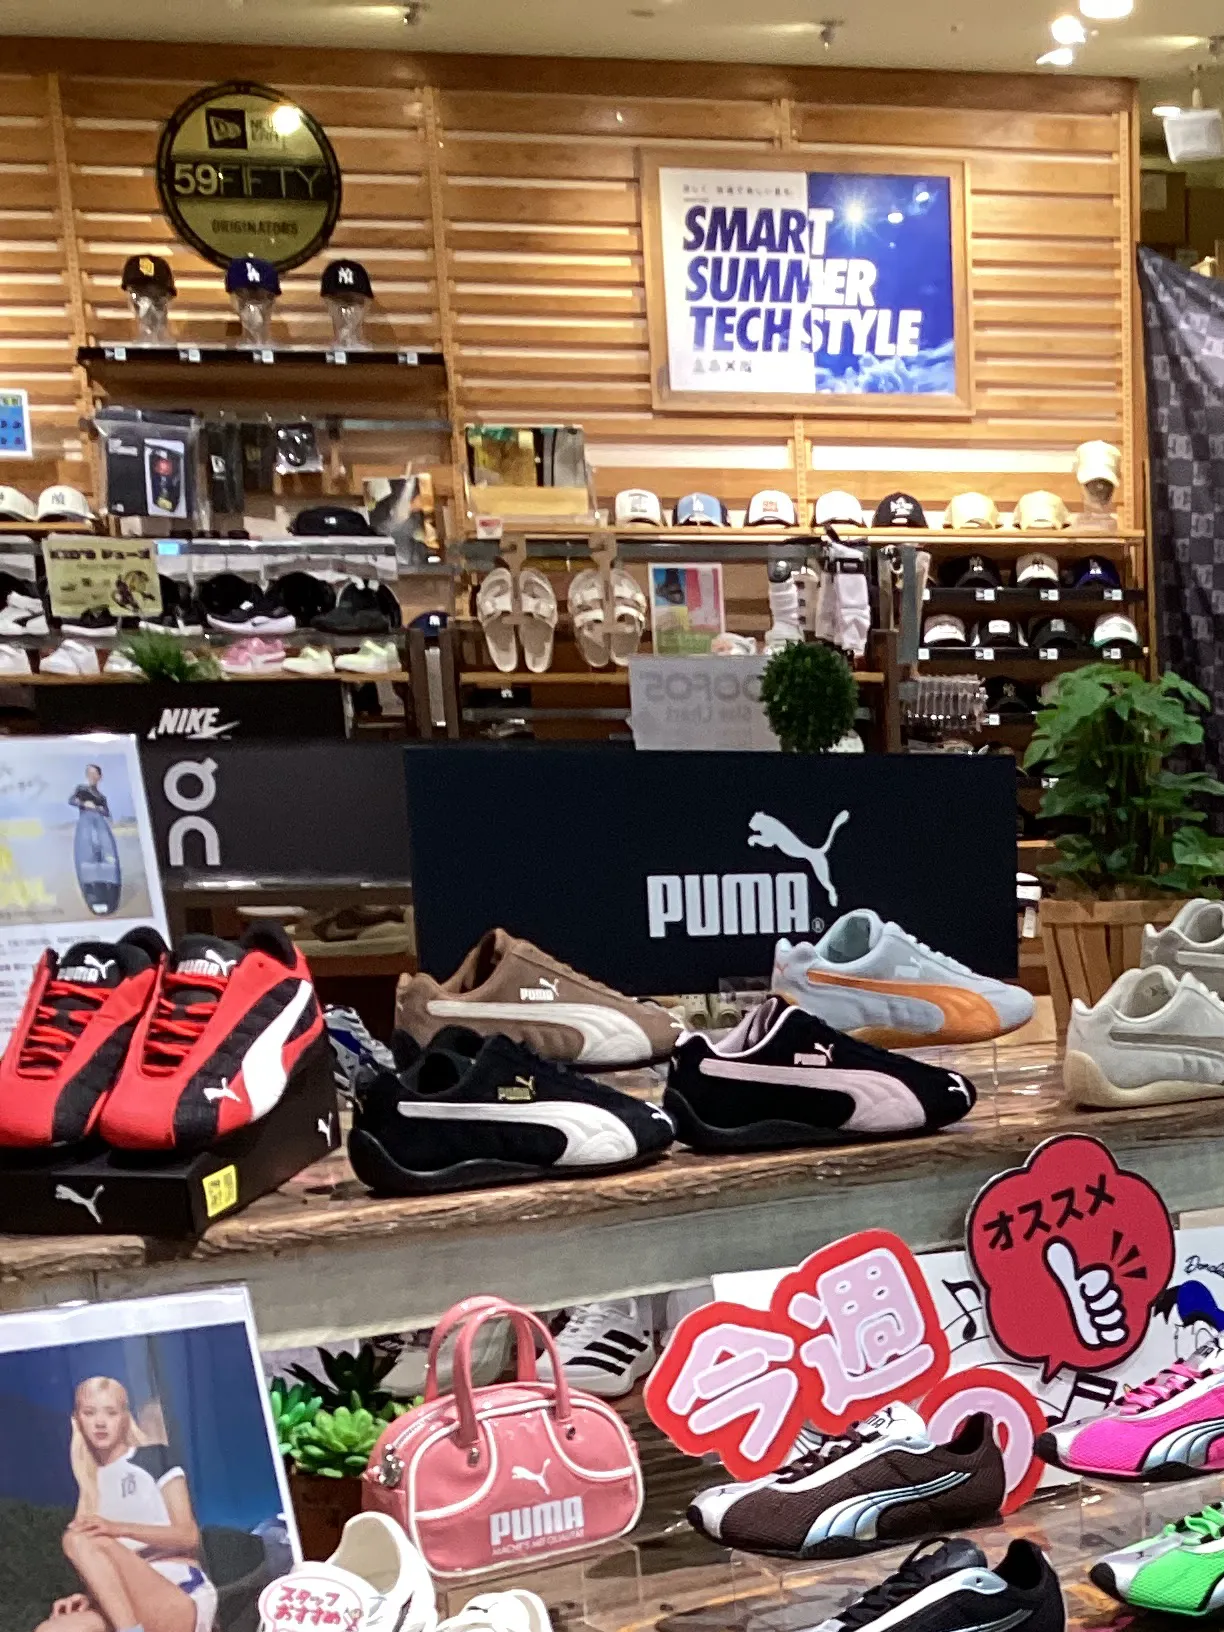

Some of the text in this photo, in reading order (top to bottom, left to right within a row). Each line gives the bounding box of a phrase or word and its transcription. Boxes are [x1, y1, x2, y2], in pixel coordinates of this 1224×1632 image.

[174, 162, 321, 199] 59FIFTY
[682, 205, 835, 256] SMART
[685, 256, 877, 307] SUMMER
[690, 306, 922, 357] TECH STYLE
[158, 707, 219, 734] NIKE
[647, 871, 811, 938] PUMA
[982, 1173, 1116, 1252] オススメ
[489, 1495, 585, 1546] PUMA
[273, 1603, 342, 1627] おすすめ
[278, 1585, 341, 1607] スタッフ
